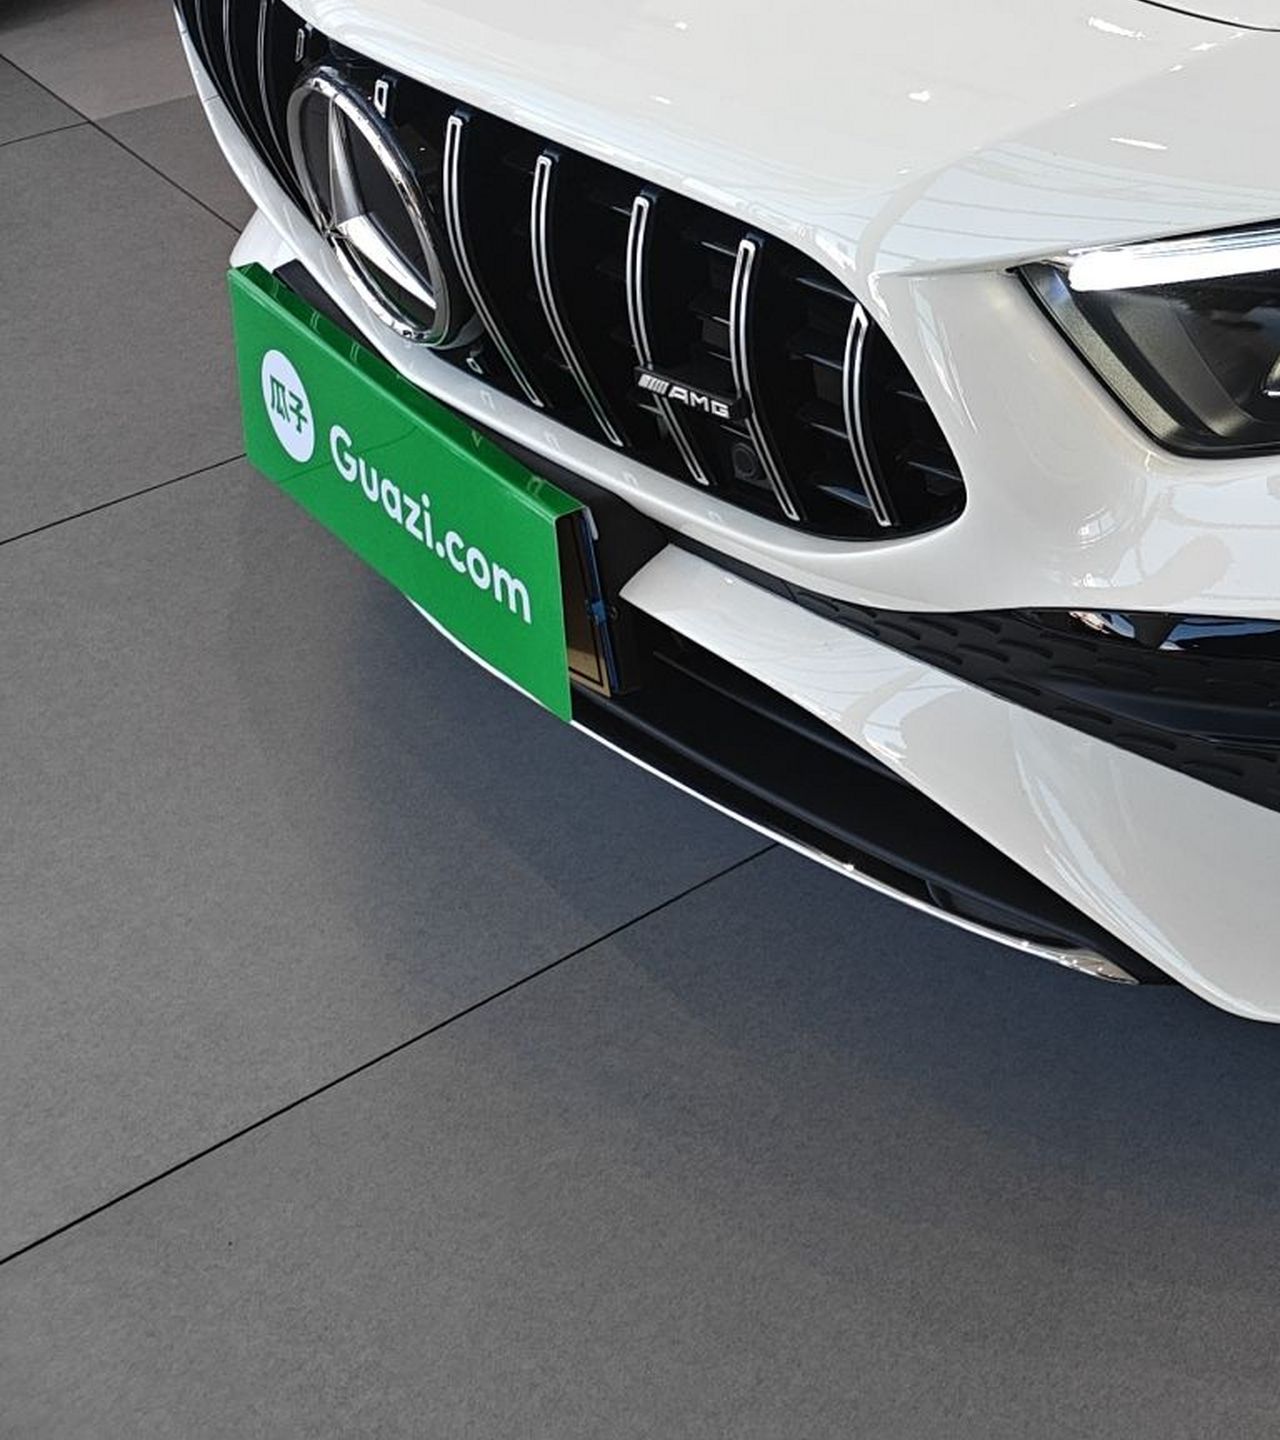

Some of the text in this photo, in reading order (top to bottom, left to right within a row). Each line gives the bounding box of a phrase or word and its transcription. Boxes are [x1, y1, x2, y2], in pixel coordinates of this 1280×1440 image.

[668, 386, 730, 419] AMG
[269, 376, 532, 624] 瓜子 Guazi.com
